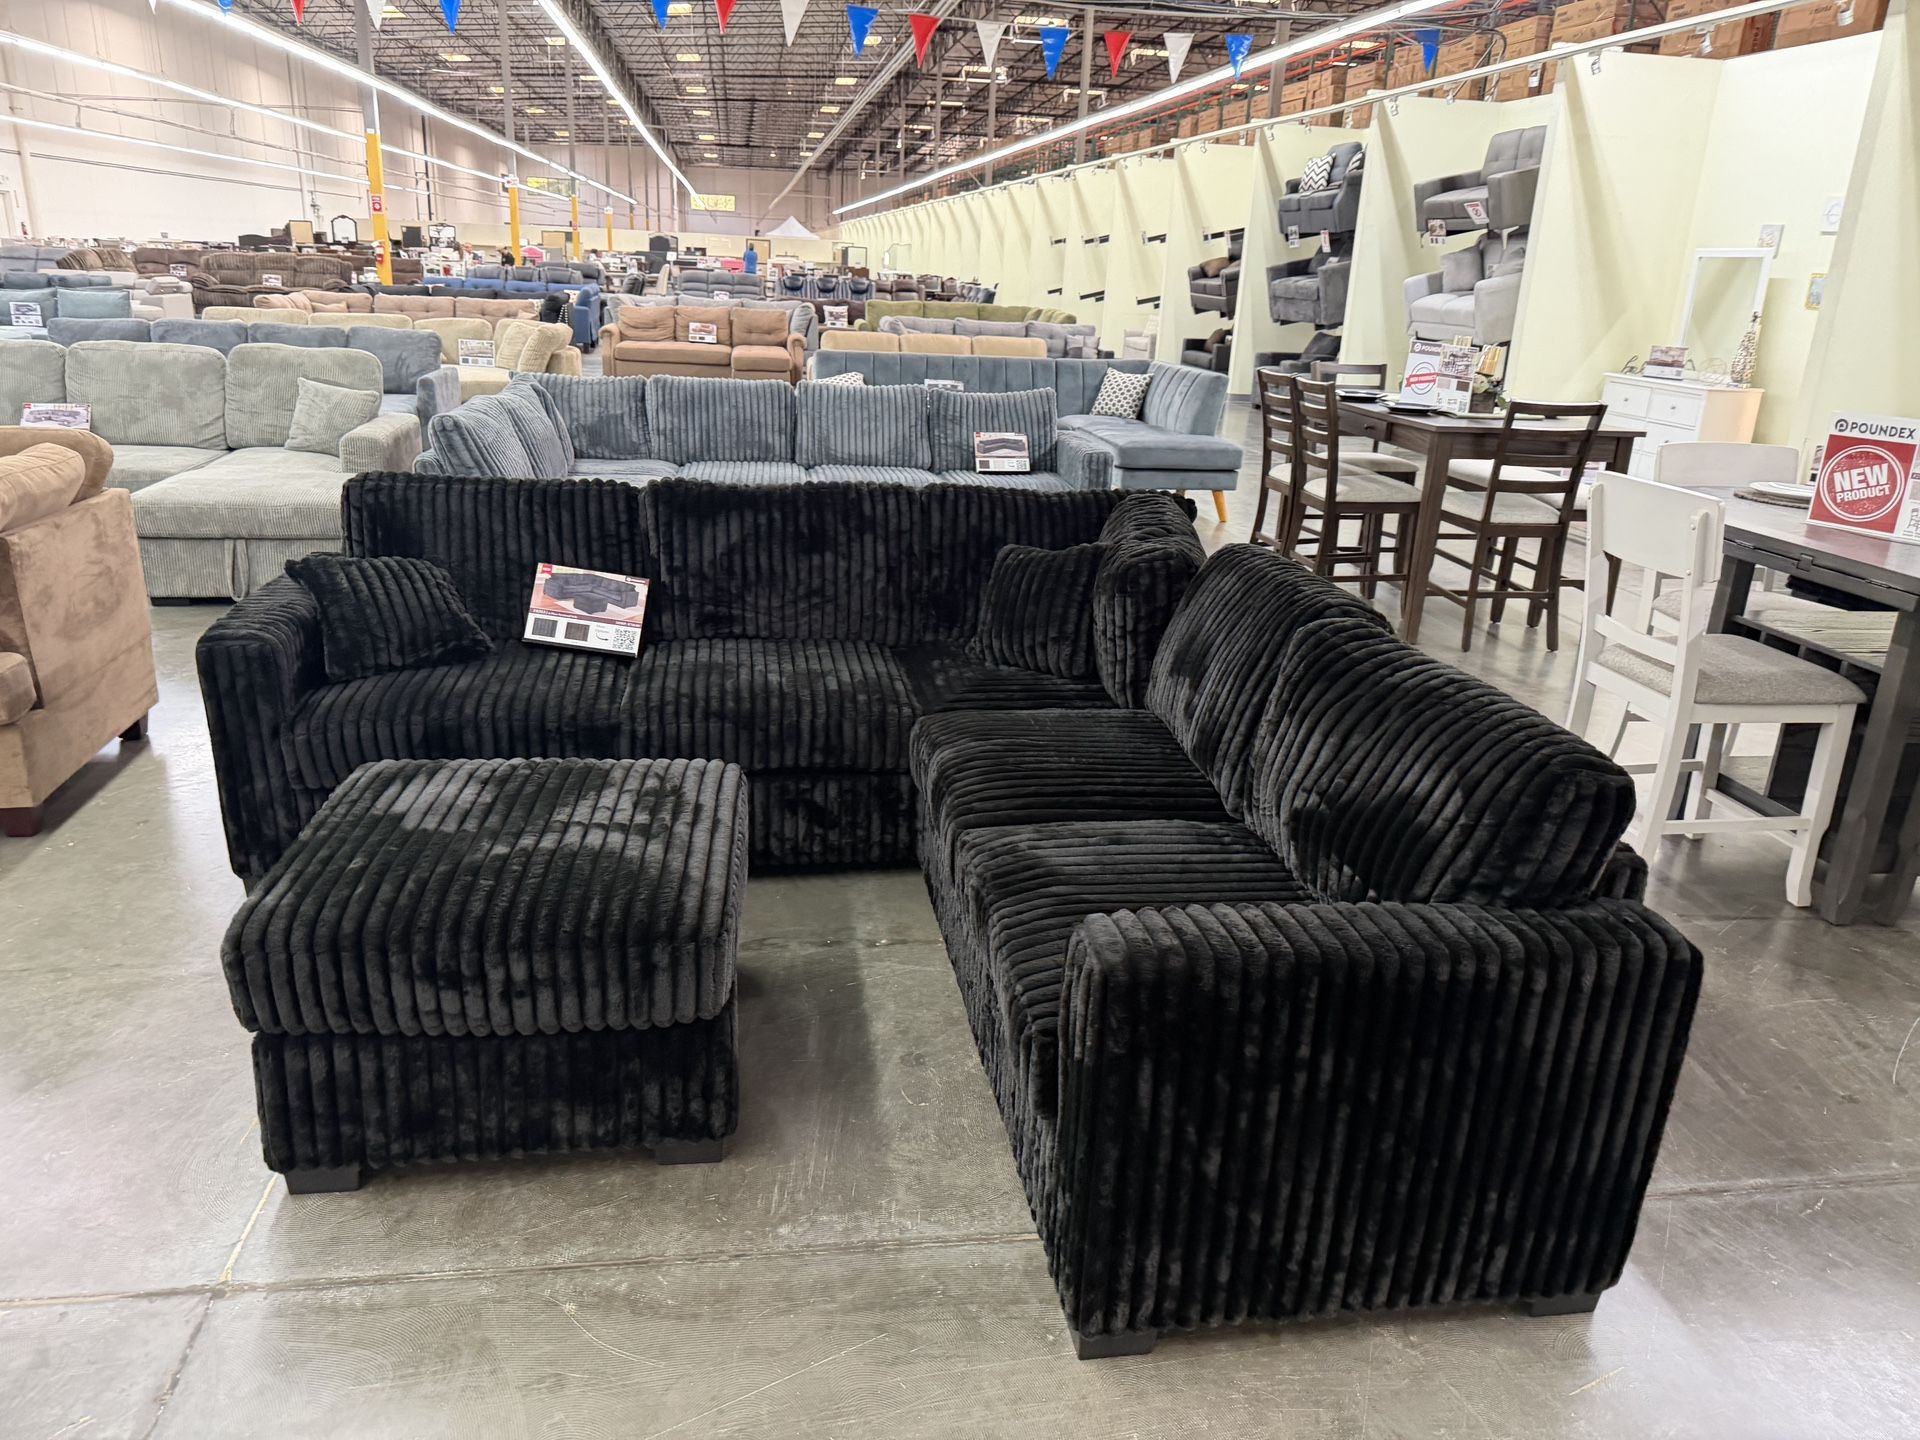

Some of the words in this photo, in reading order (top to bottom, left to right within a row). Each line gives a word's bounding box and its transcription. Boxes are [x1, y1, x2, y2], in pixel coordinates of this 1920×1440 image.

[1849, 421, 1917, 440] POUNDEX
[1833, 463, 1889, 493] NEW
[1835, 484, 1891, 503] PRODUCT
